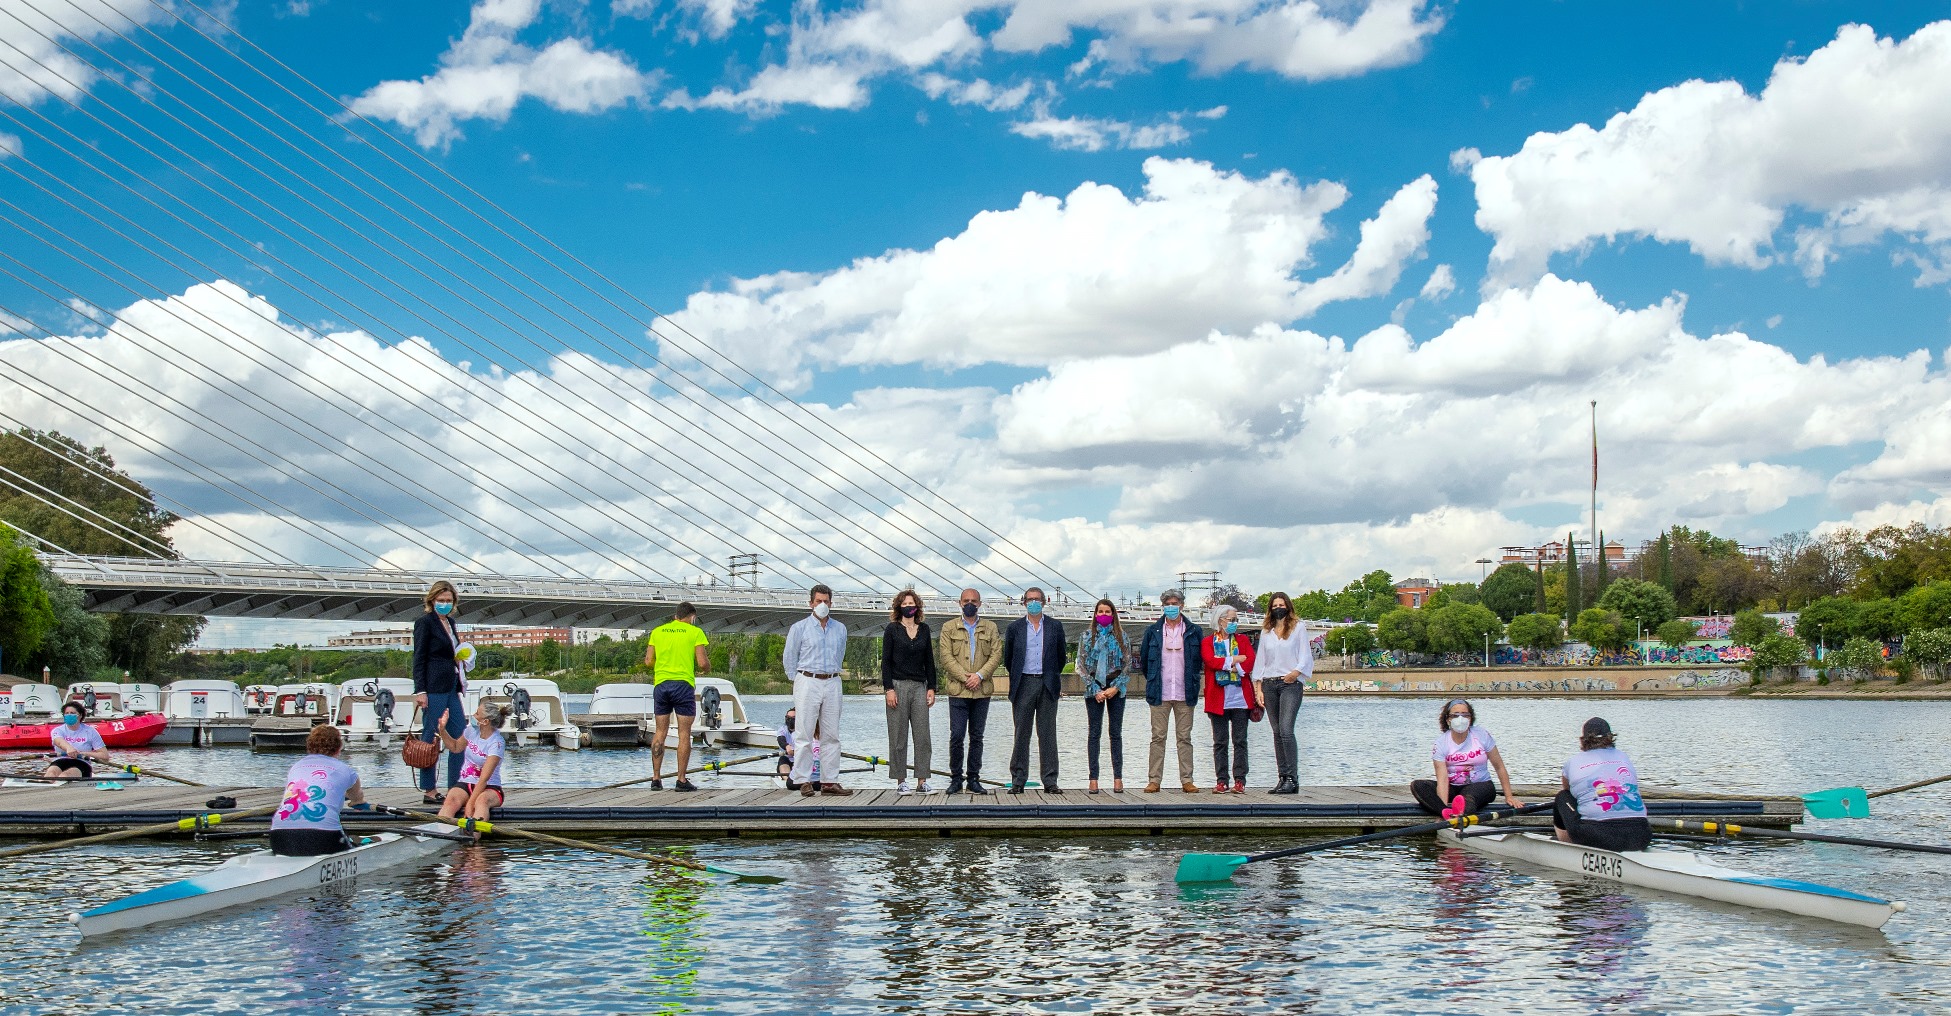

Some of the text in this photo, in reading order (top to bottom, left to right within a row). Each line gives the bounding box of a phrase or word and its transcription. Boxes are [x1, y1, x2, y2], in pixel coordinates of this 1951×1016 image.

[30, 684, 36, 693] 7
[135, 684, 141, 692] 8
[0, 696, 10, 705] 23
[193, 697, 206, 705] 24
[104, 702, 112, 711] 2
[308, 702, 315, 710] 4
[112, 721, 126, 732] 23
[1581, 851, 1623, 879] CEAR-Y5
[320, 856, 358, 884] CEAR-Y15
